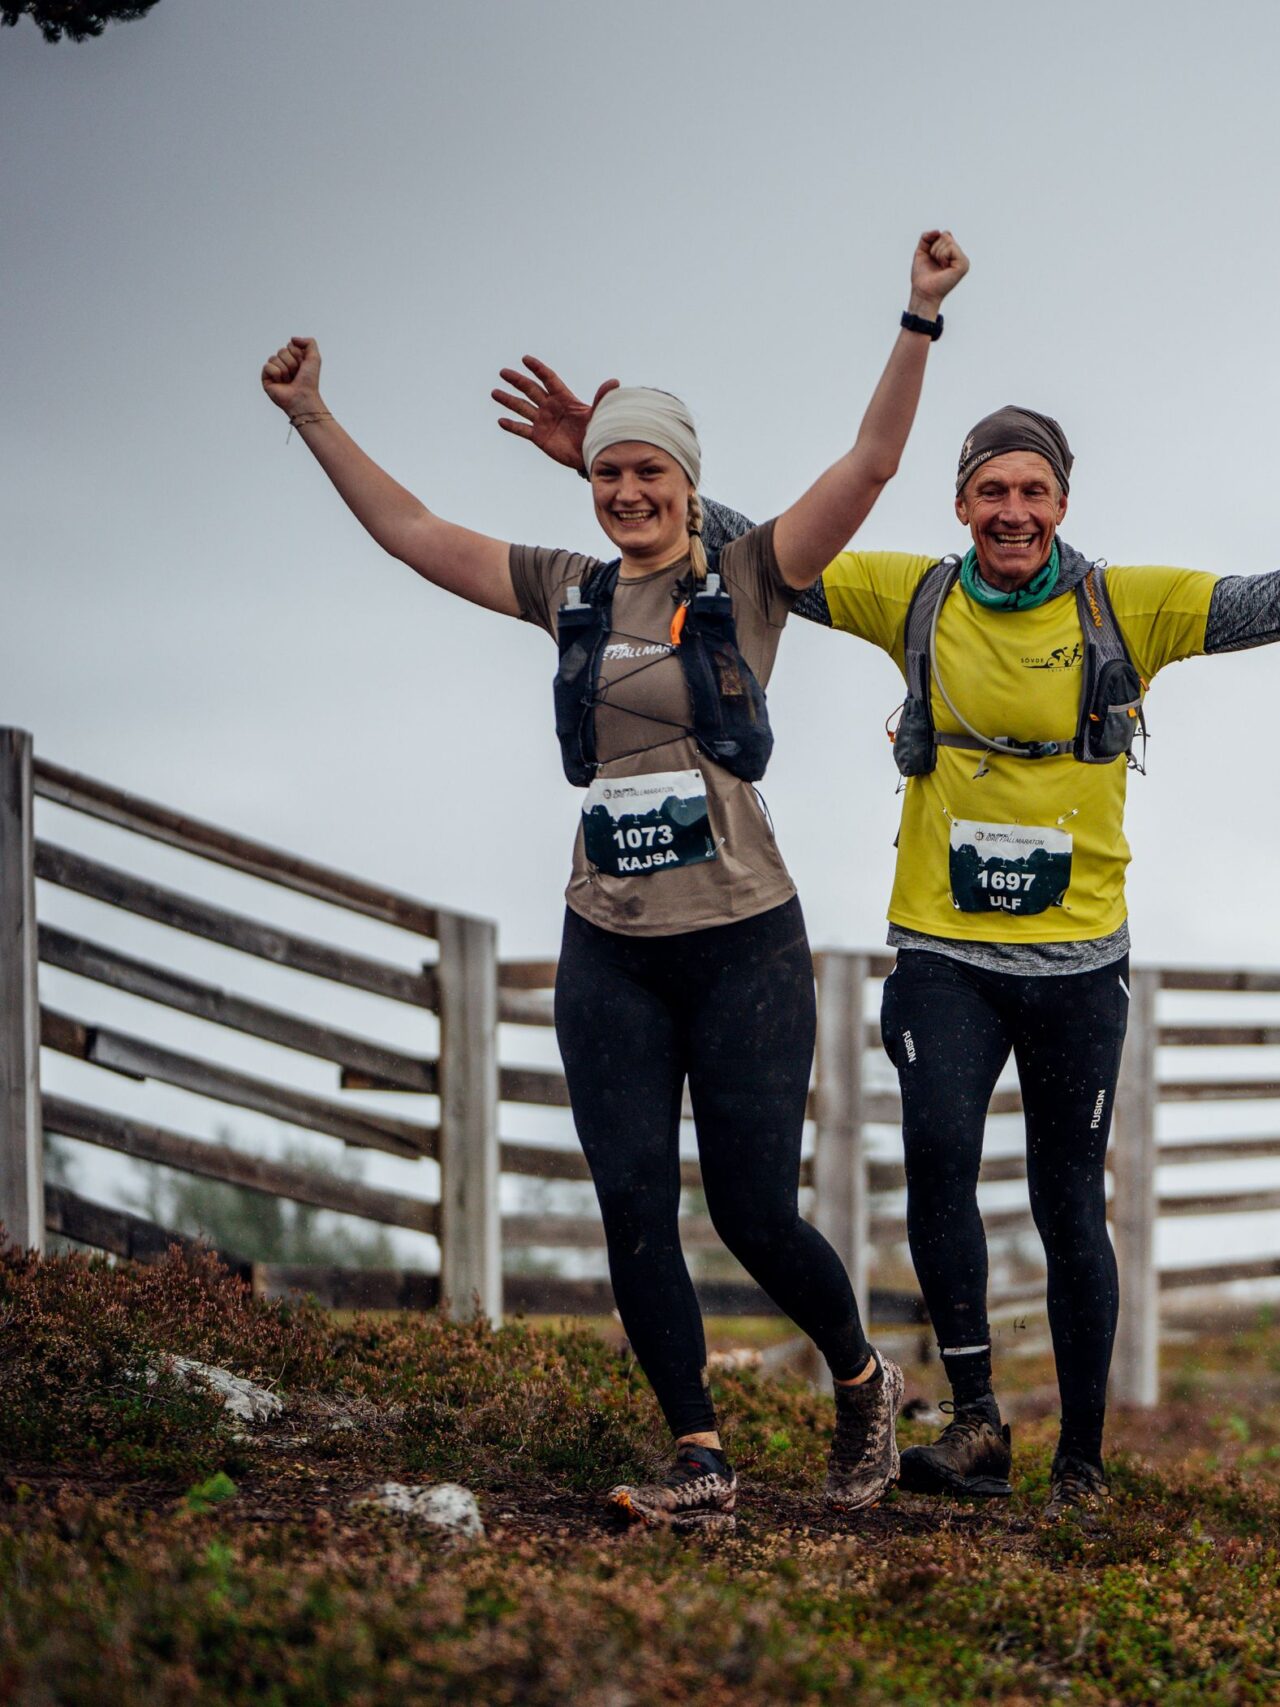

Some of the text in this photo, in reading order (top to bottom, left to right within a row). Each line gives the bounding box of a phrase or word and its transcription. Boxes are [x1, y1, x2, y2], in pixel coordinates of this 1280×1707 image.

[613, 825, 674, 849] 1073
[617, 849, 680, 872] KAJSA
[977, 870, 1036, 891] 1697
[989, 895, 1022, 910] ULF
[902, 1030, 917, 1063] FUSION
[1090, 1089, 1106, 1129] FUSION
